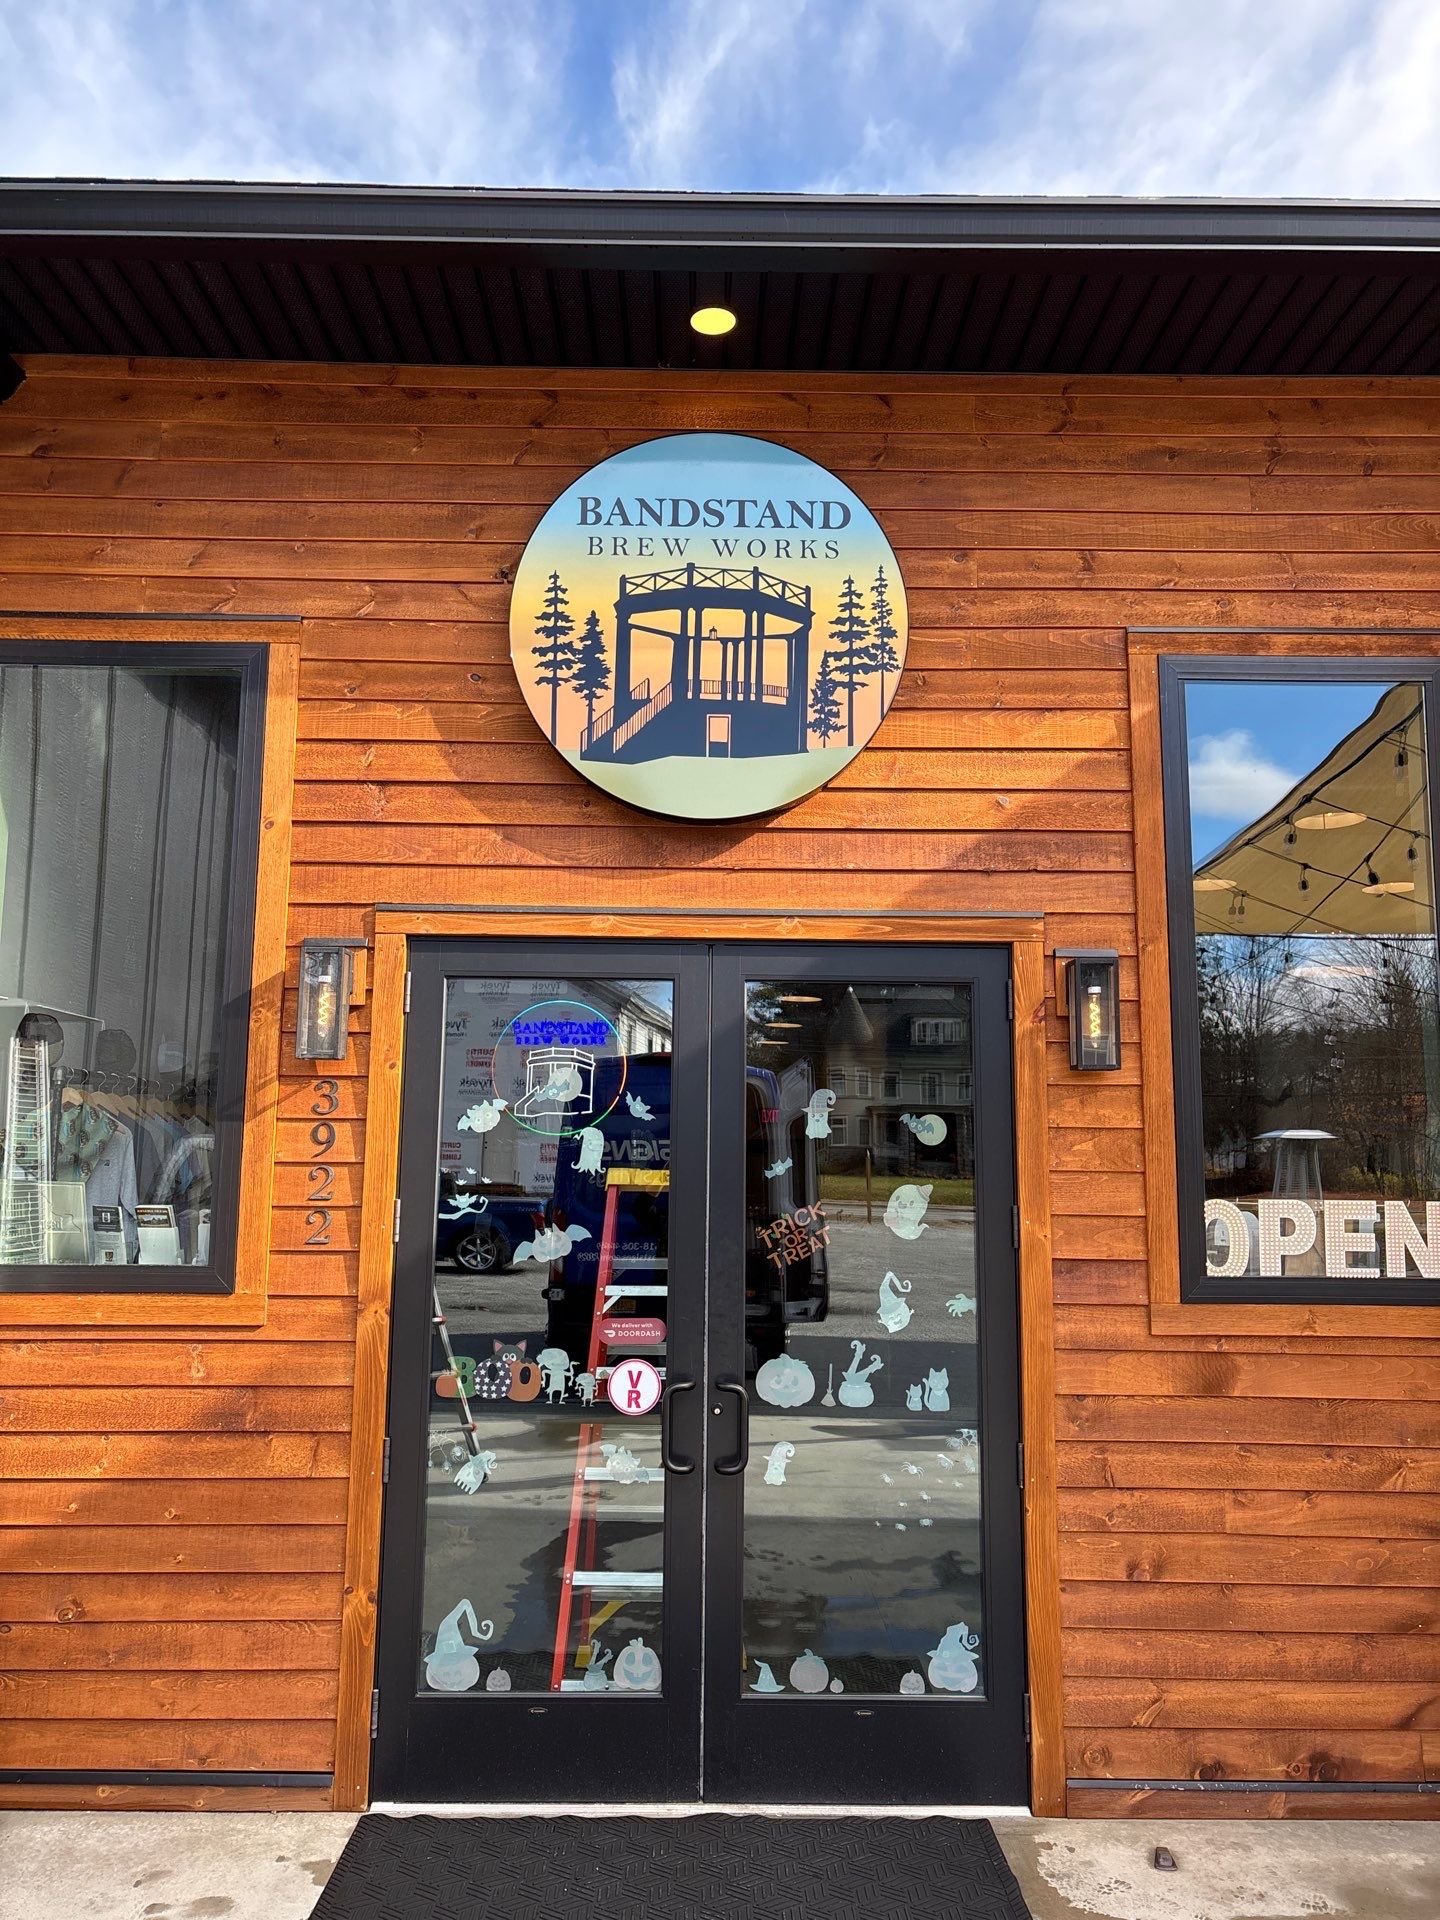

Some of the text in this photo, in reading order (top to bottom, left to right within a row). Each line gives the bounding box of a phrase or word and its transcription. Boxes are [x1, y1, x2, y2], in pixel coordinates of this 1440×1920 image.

[577, 496, 851, 530] BANDSTAND
[586, 536, 840, 559] BREW WORKS
[761, 1200, 827, 1249] TRICK
[784, 1228, 809, 1248] OR
[1204, 1199, 1440, 1278] OPEN
[766, 1225, 831, 1269] TREAT
[447, 1355, 541, 1402] BOO
